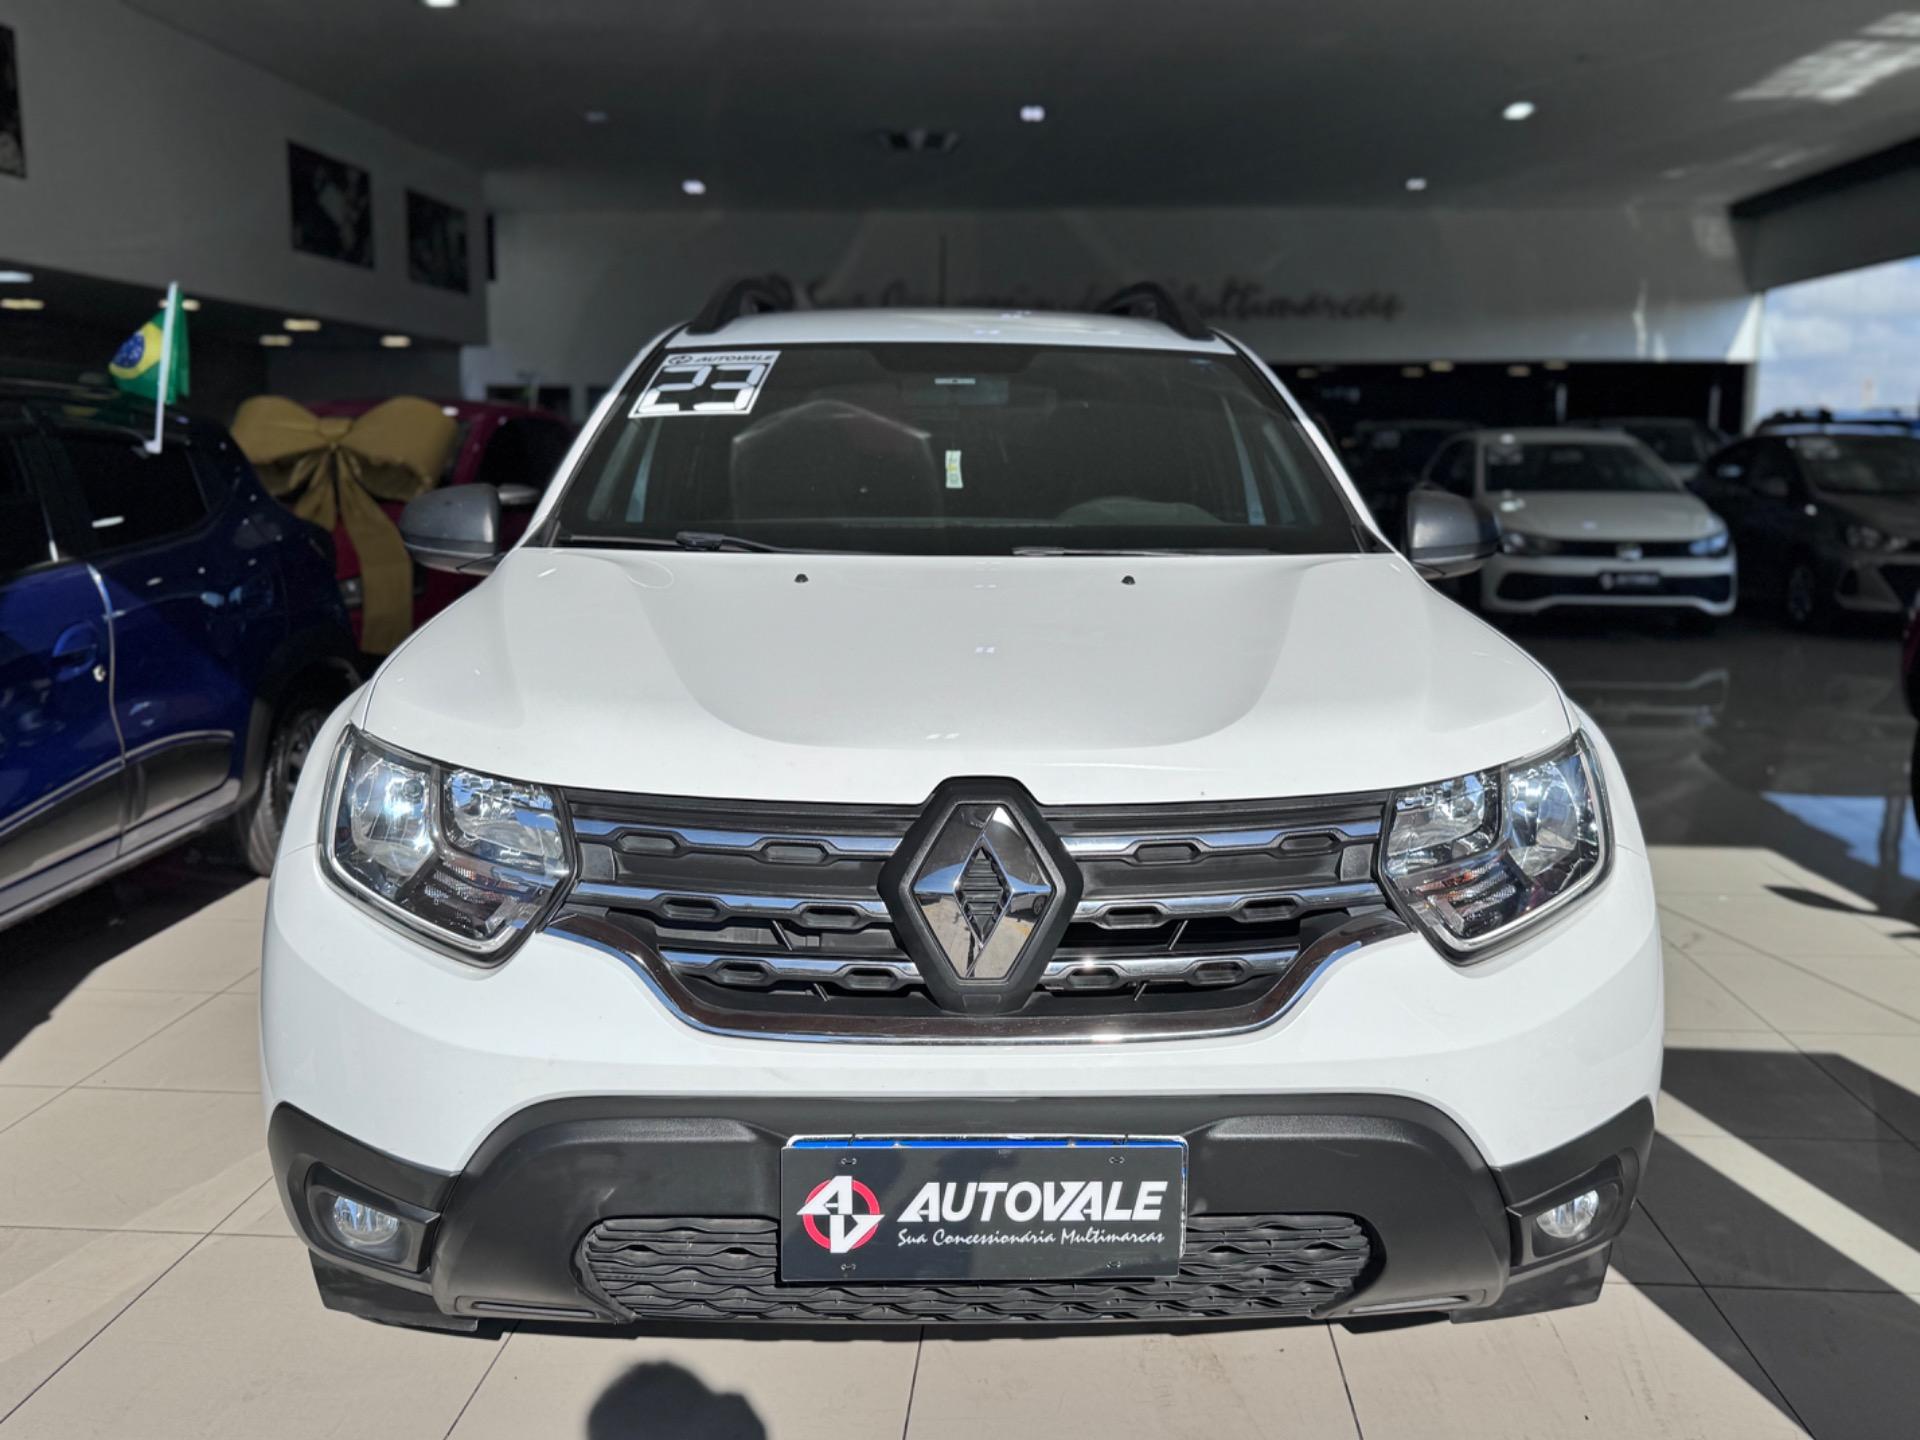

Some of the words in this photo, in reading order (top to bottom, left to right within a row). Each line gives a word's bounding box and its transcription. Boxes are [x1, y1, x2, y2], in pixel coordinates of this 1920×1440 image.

[696, 353, 774, 363] AUTOVALE
[637, 364, 766, 412] 23
[897, 1181, 1168, 1222] AUTOVALE
[898, 1229, 927, 1247] Sua
[1060, 1227, 1165, 1244] Multimarcas
